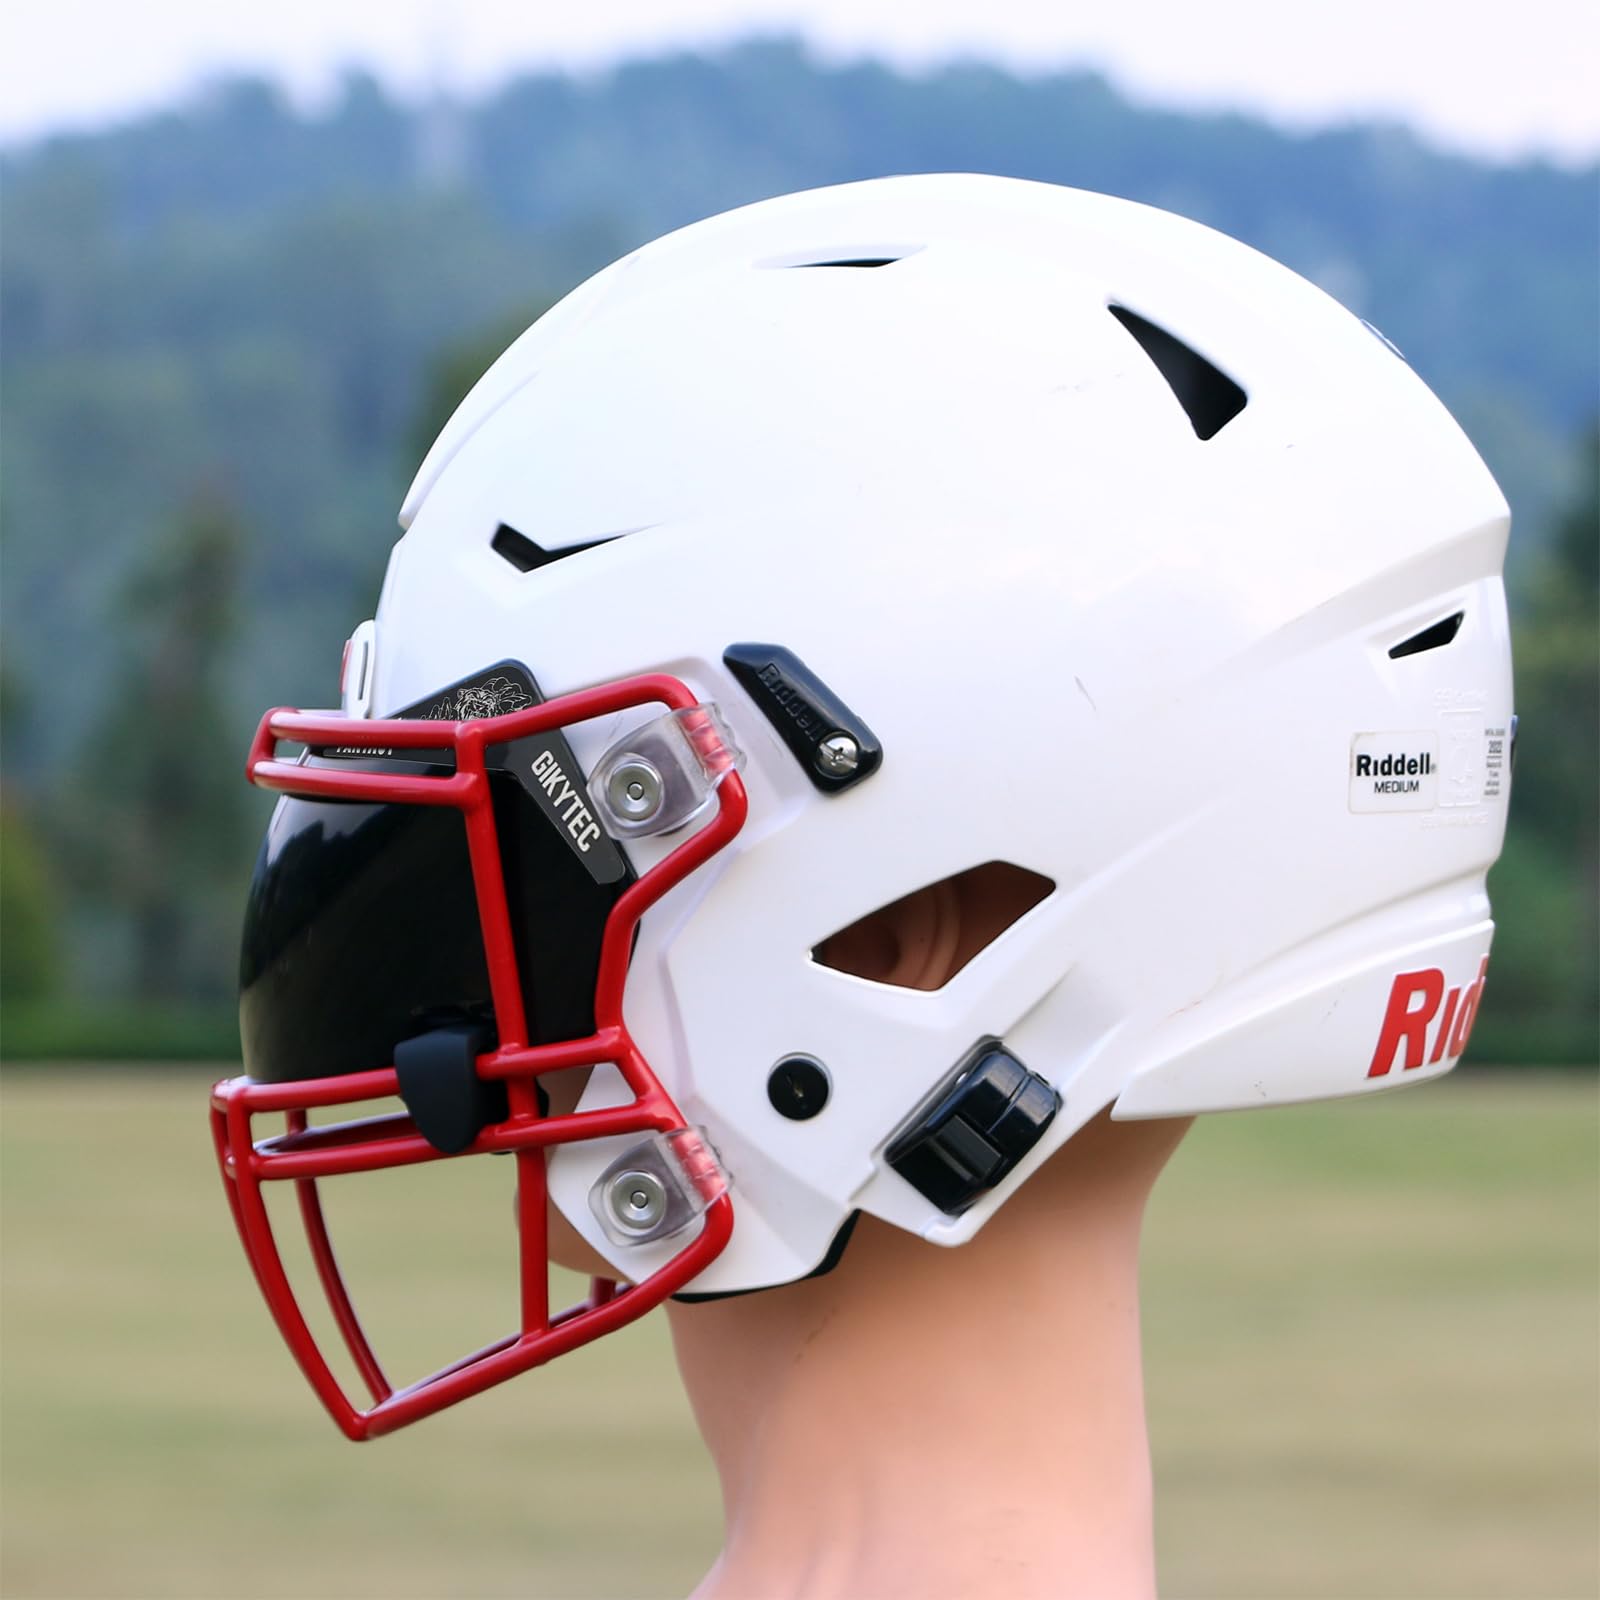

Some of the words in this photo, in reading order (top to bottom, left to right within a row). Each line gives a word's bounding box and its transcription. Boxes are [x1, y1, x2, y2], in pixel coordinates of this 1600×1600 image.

[757, 663, 826, 742] Riddell
[1356, 752, 1431, 777] Riddell
[1374, 780, 1420, 793] MEDIUM
[531, 750, 601, 852] GIKYTEC
